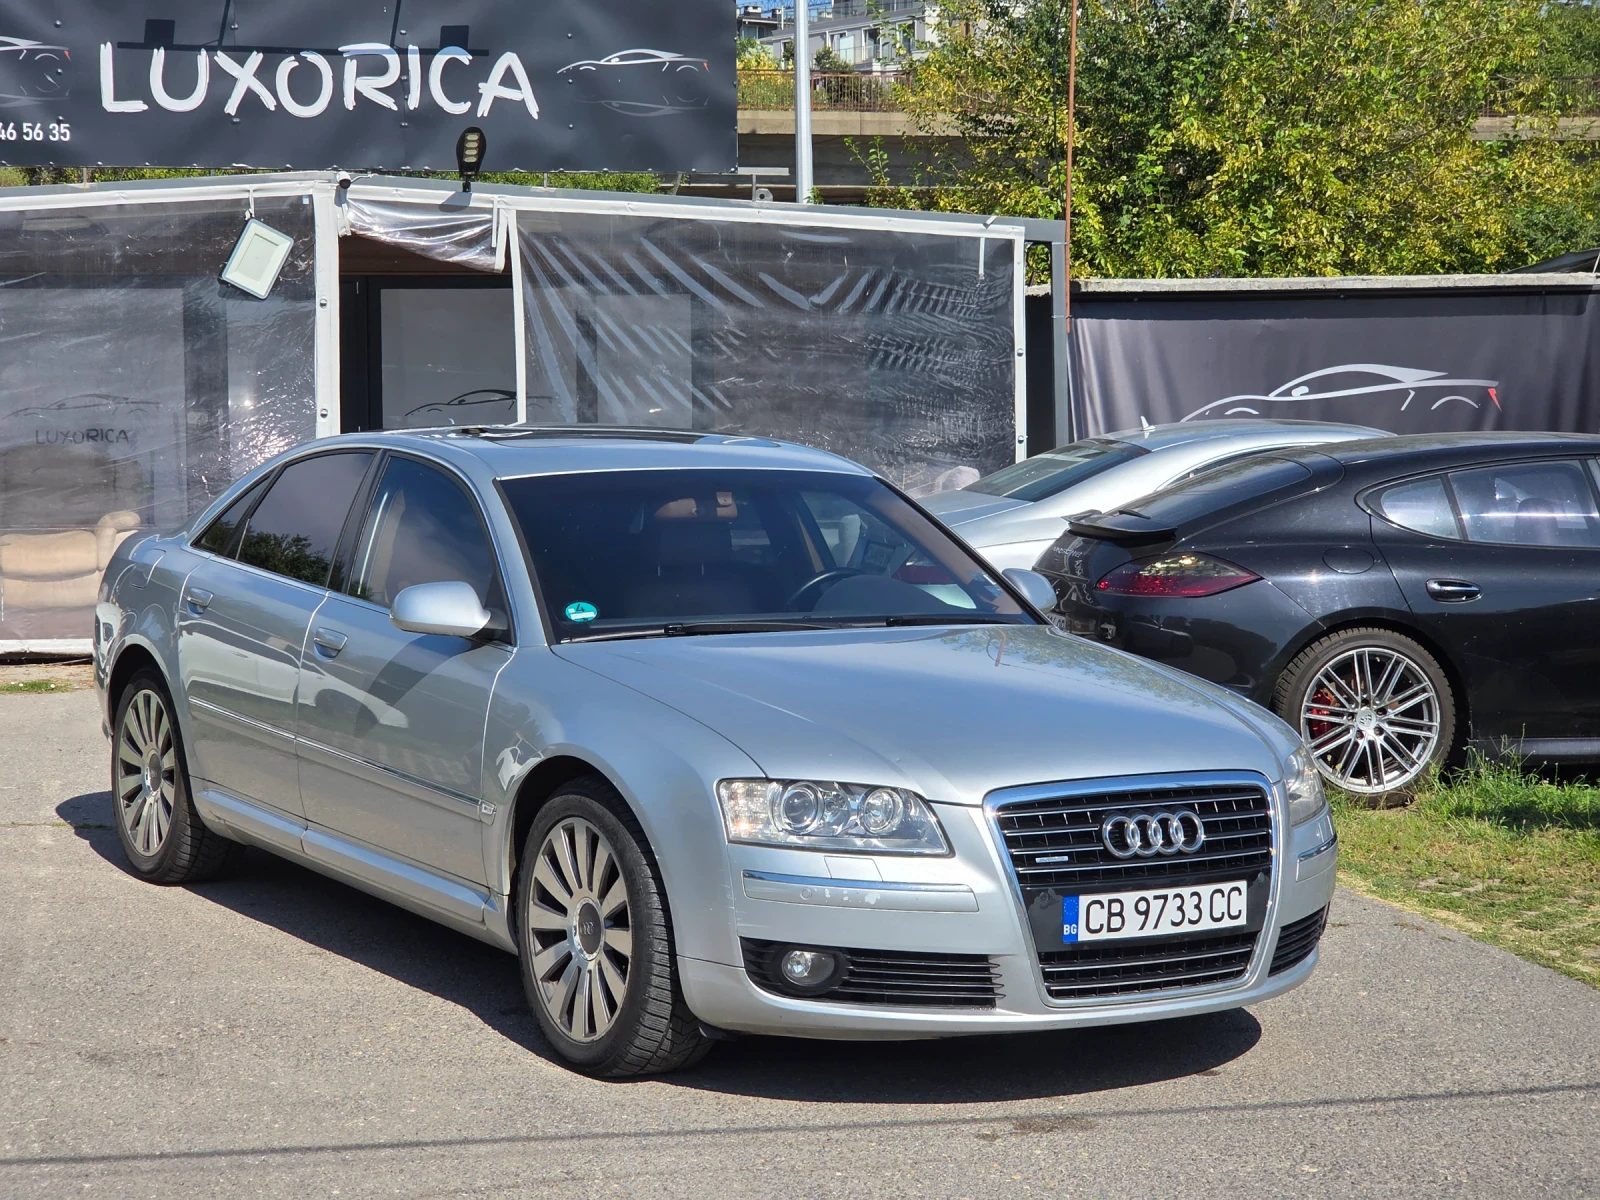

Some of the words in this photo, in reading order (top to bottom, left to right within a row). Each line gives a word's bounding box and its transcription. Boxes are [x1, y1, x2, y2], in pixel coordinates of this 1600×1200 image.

[99, 41, 540, 121] LUXORICA
[22, 122, 44, 141] 56
[48, 123, 71, 142] 35
[35, 428, 129, 445] LUXORICA
[1063, 924, 1078, 936] BG
[1085, 898, 1126, 934] CB
[1134, 891, 1203, 931] 9733
[1209, 886, 1242, 923] CC
